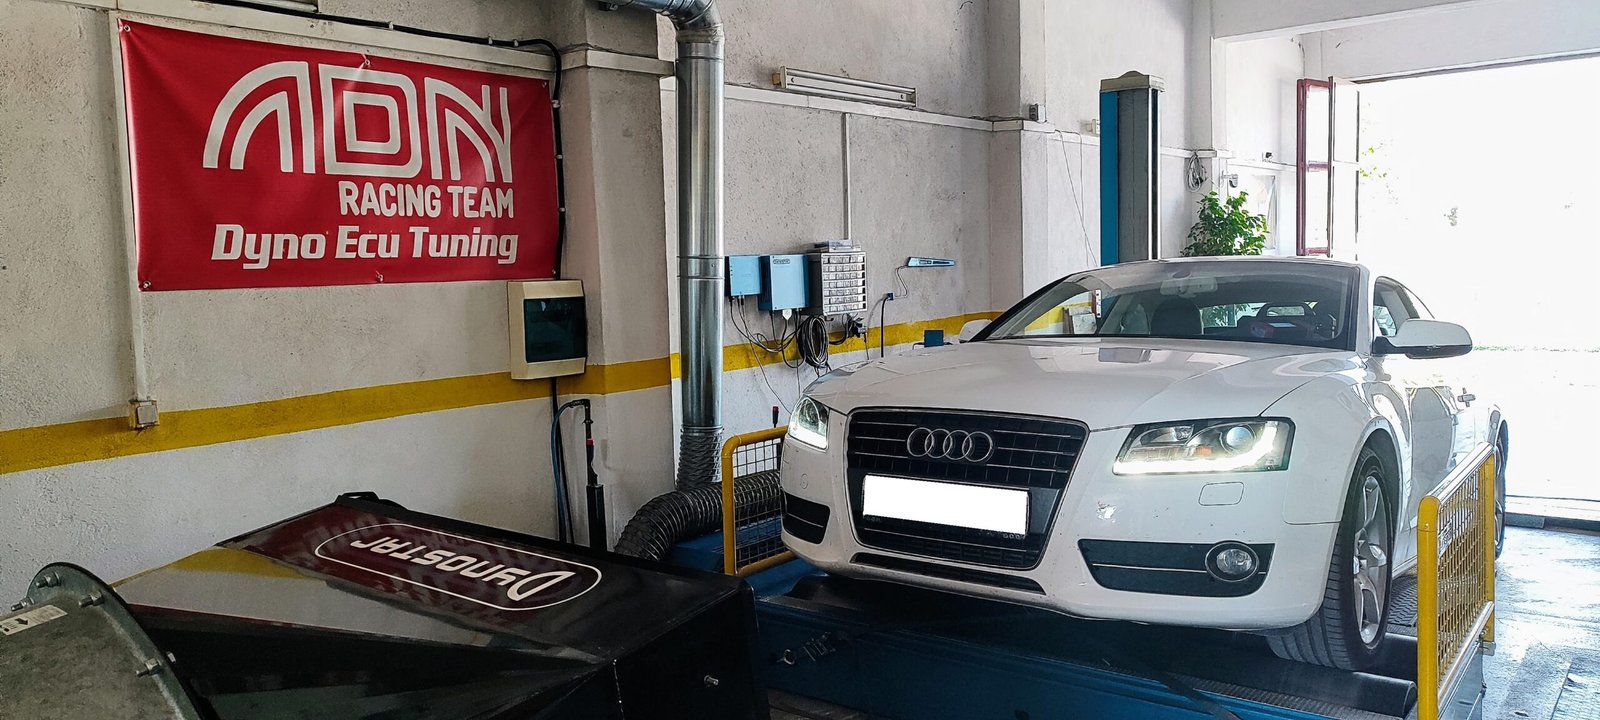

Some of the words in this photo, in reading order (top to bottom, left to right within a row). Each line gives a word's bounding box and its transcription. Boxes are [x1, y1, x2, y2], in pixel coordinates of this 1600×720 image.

[338, 181, 441, 218] RACING
[447, 186, 514, 218] TEAM
[211, 223, 327, 270] Dyno
[335, 225, 399, 259] Ecu
[409, 226, 518, 264] Tuning
[350, 536, 576, 601] DYNOSTAR
